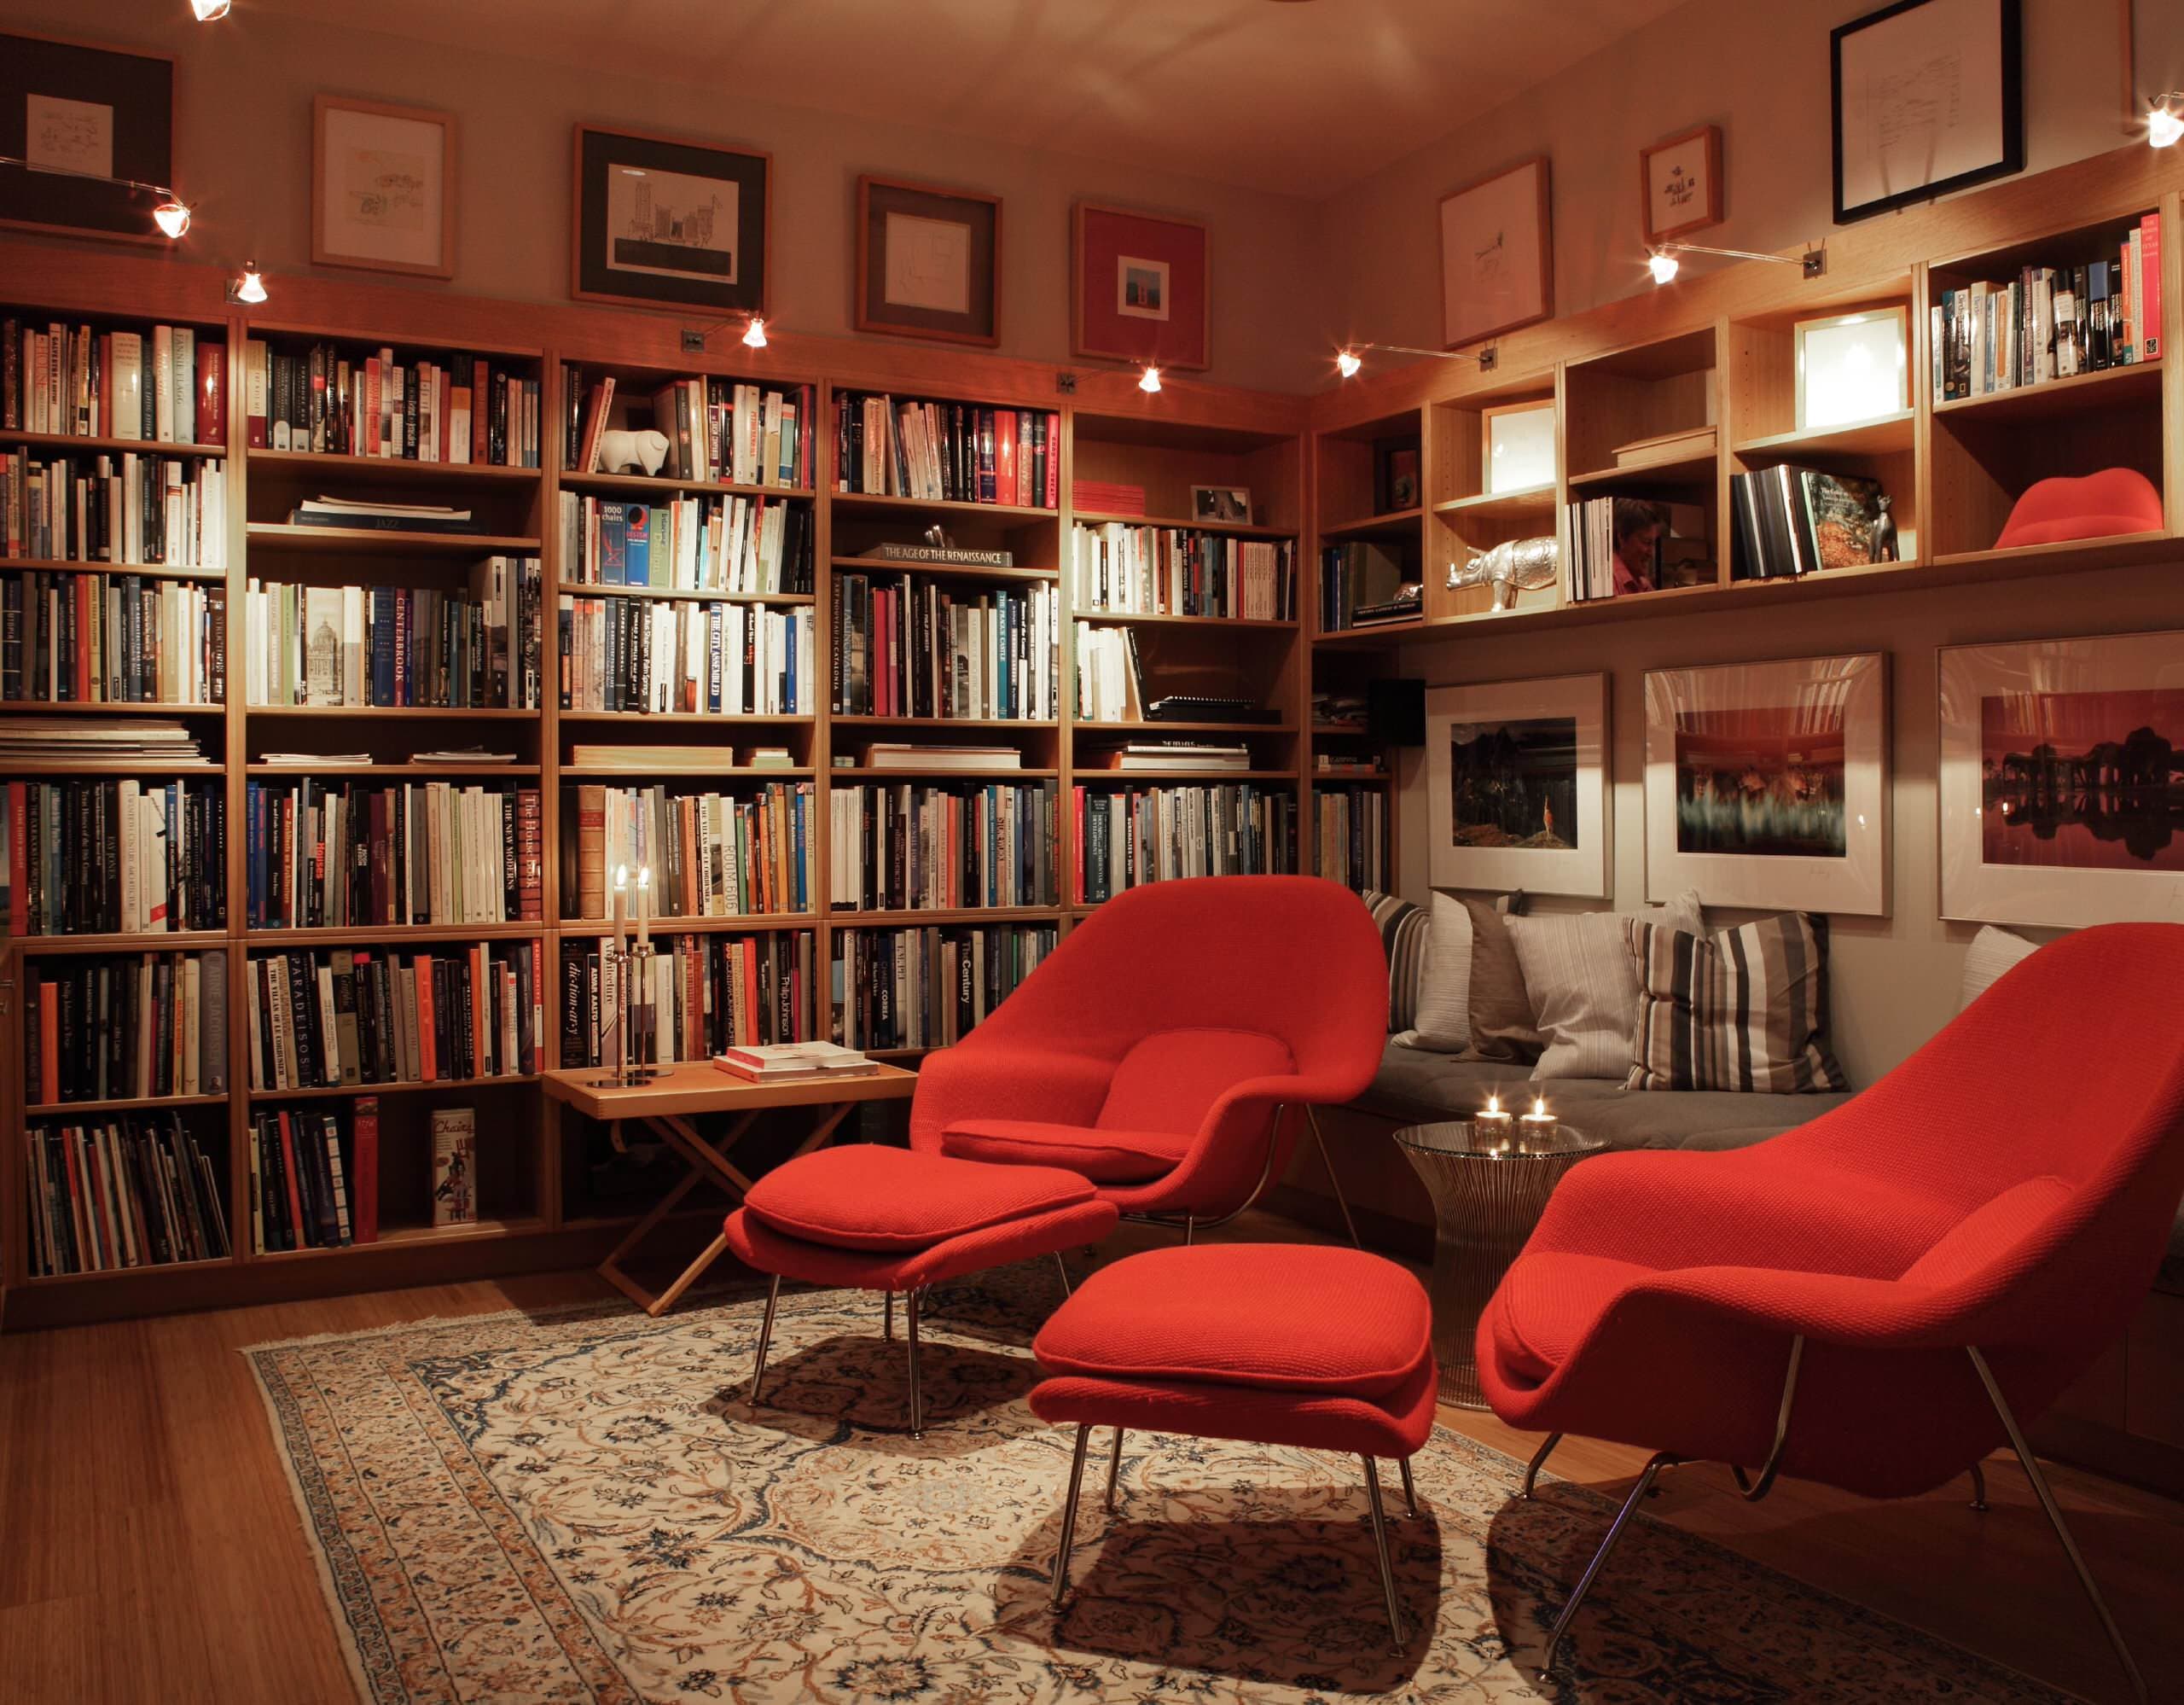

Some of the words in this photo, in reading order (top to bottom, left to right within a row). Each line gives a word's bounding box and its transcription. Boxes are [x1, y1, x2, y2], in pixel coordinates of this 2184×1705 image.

[885, 547, 902, 559] THE
[902, 548, 919, 560] AGE
[918, 550, 930, 560] OF
[931, 550, 946, 562] THE
[947, 551, 1002, 565] RENAISSANCE
[712, 614, 721, 631] THE
[396, 596, 404, 682] CENTERBROOK
[712, 631, 721, 650] CITY
[712, 650, 721, 696] ASSEMBLED
[506, 804, 514, 823] THE
[506, 823, 514, 844] NEW
[506, 846, 514, 890] MODERNS
[724, 845, 737, 882] ROOM
[724, 885, 737, 910] 606
[961, 940, 971, 961] The
[781, 976, 792, 998] Philip
[961, 959, 971, 1004] Century
[274, 1014, 281, 1022] OF
[781, 999, 792, 1036] Johnson
[276, 1035, 285, 1076] CORBUSIER
